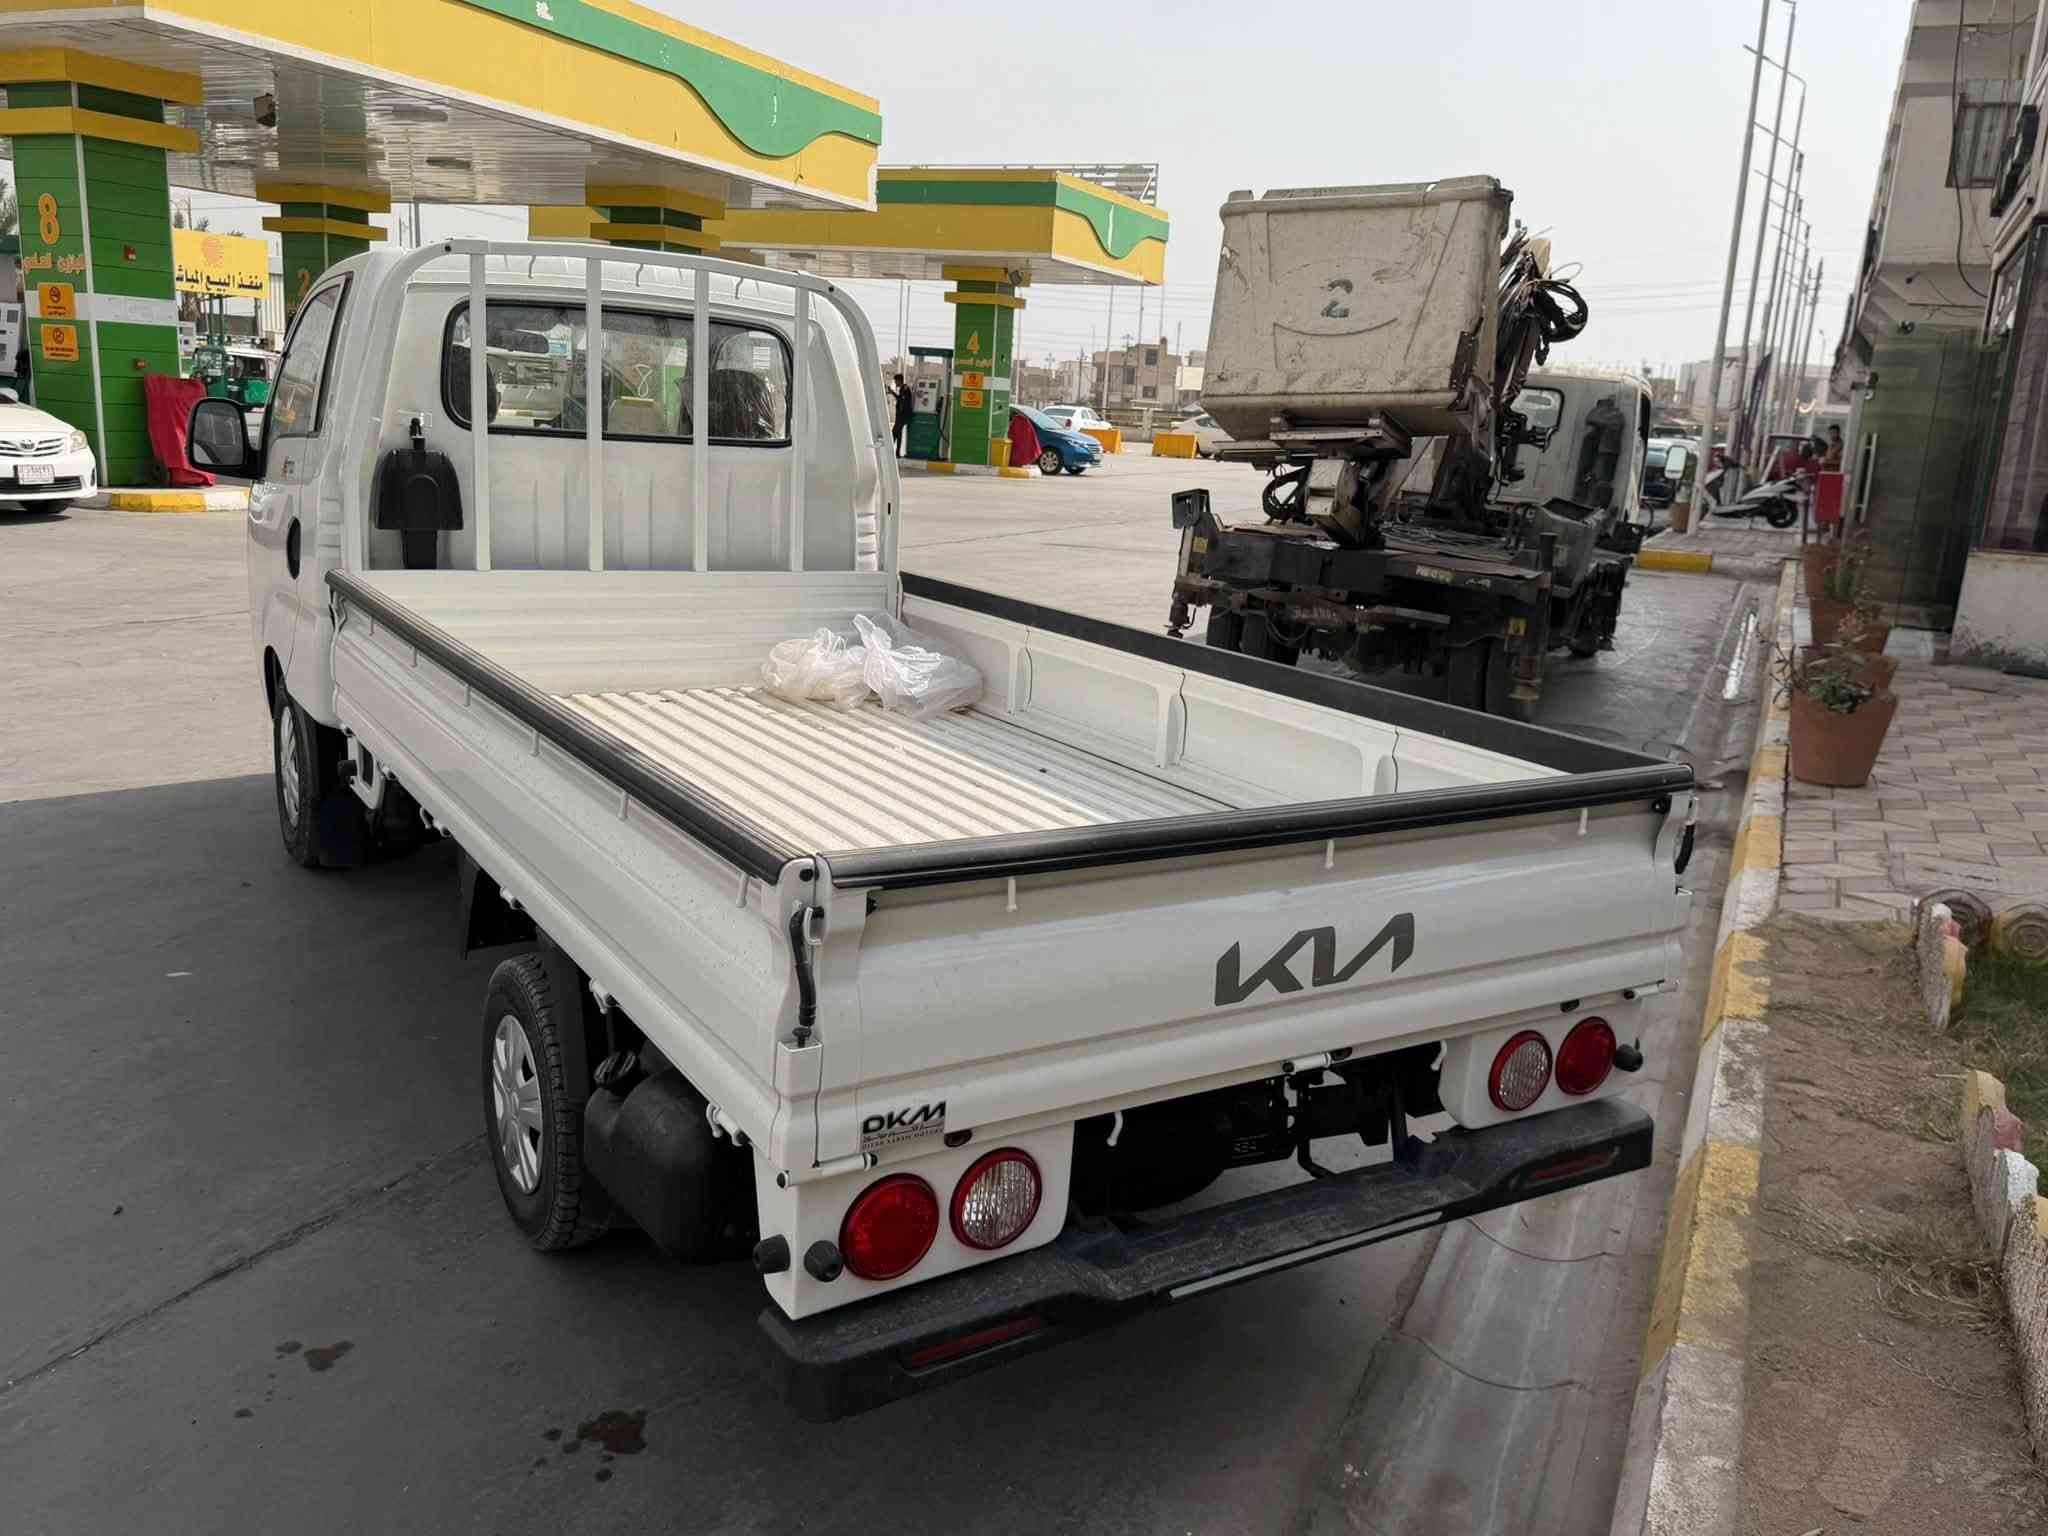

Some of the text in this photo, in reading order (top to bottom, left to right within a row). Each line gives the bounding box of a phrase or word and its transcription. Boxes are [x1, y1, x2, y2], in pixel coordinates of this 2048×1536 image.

[38, 192, 60, 245] 8
[175, 264, 263, 291] منفذ البيع المباش
[966, 330, 980, 355] 4
[1214, 912, 1415, 1007] KIA
[862, 1100, 947, 1134] DKM
